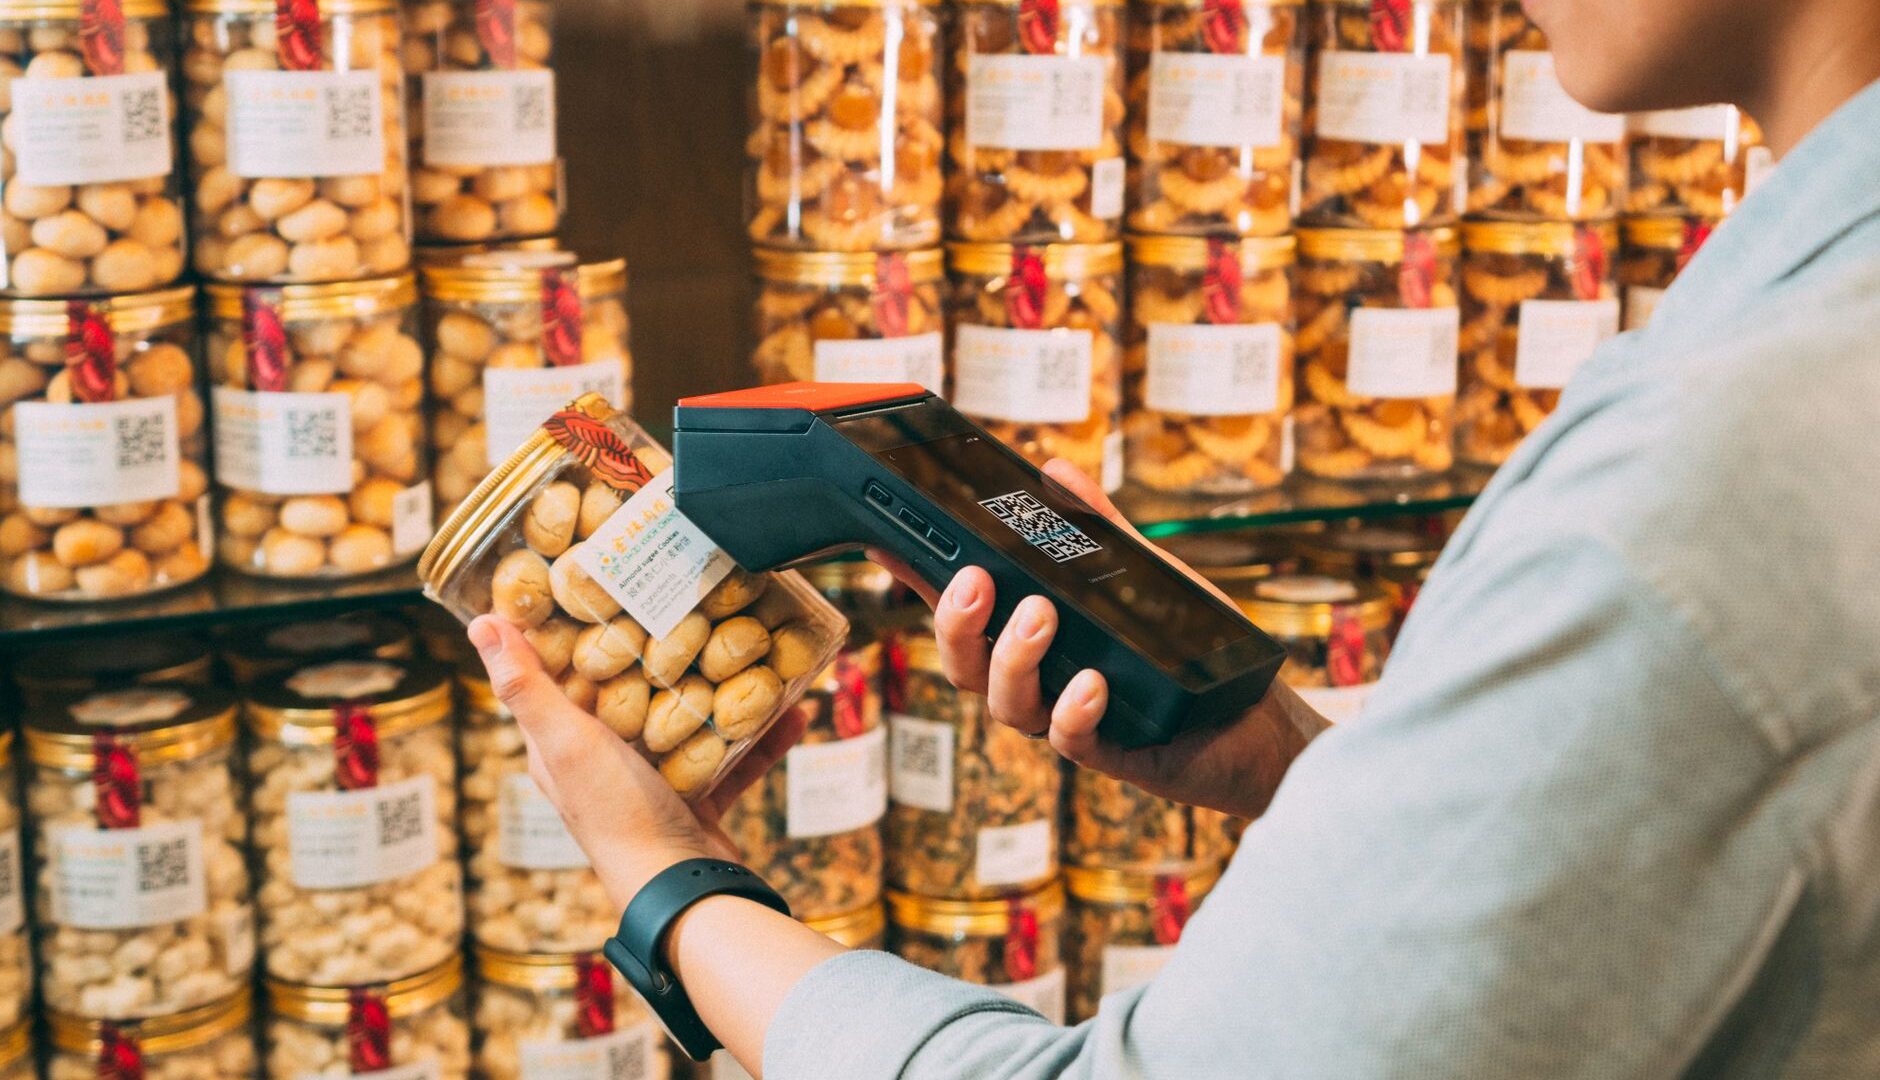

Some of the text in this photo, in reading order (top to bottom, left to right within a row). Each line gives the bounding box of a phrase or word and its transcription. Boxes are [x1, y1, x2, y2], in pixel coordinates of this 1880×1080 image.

[618, 530, 680, 589] Almond sugee Cookies
